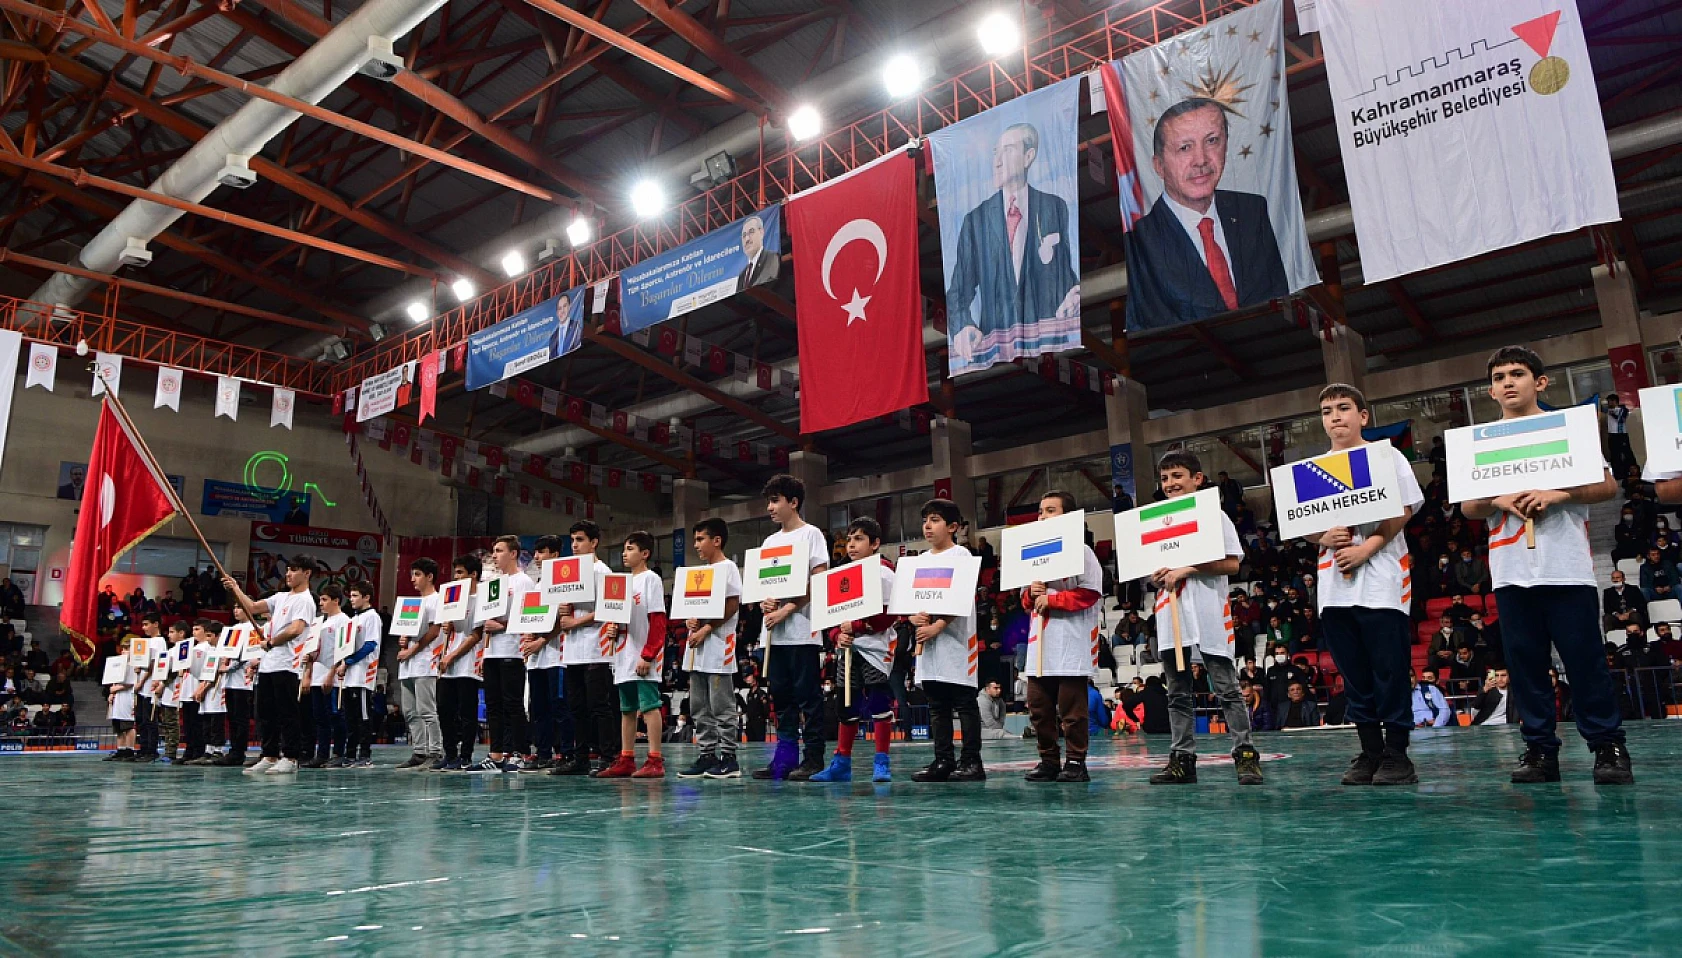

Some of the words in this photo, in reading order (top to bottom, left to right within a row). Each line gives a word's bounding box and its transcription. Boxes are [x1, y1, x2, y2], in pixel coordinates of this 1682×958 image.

[1351, 58, 1522, 126] Kahramanmaraş
[1353, 107, 1439, 149] Büyükşehir
[1441, 76, 1527, 119] Belediyesi
[1471, 455, 1574, 481] ÖZBEKİSTAN
[1287, 500, 1330, 521] BOSNA
[1332, 486, 1388, 511] HERSEK
[914, 590, 943, 600] RUSYA
[520, 615, 545, 624] BELARUS
[76, 742, 98, 750] POLİS
